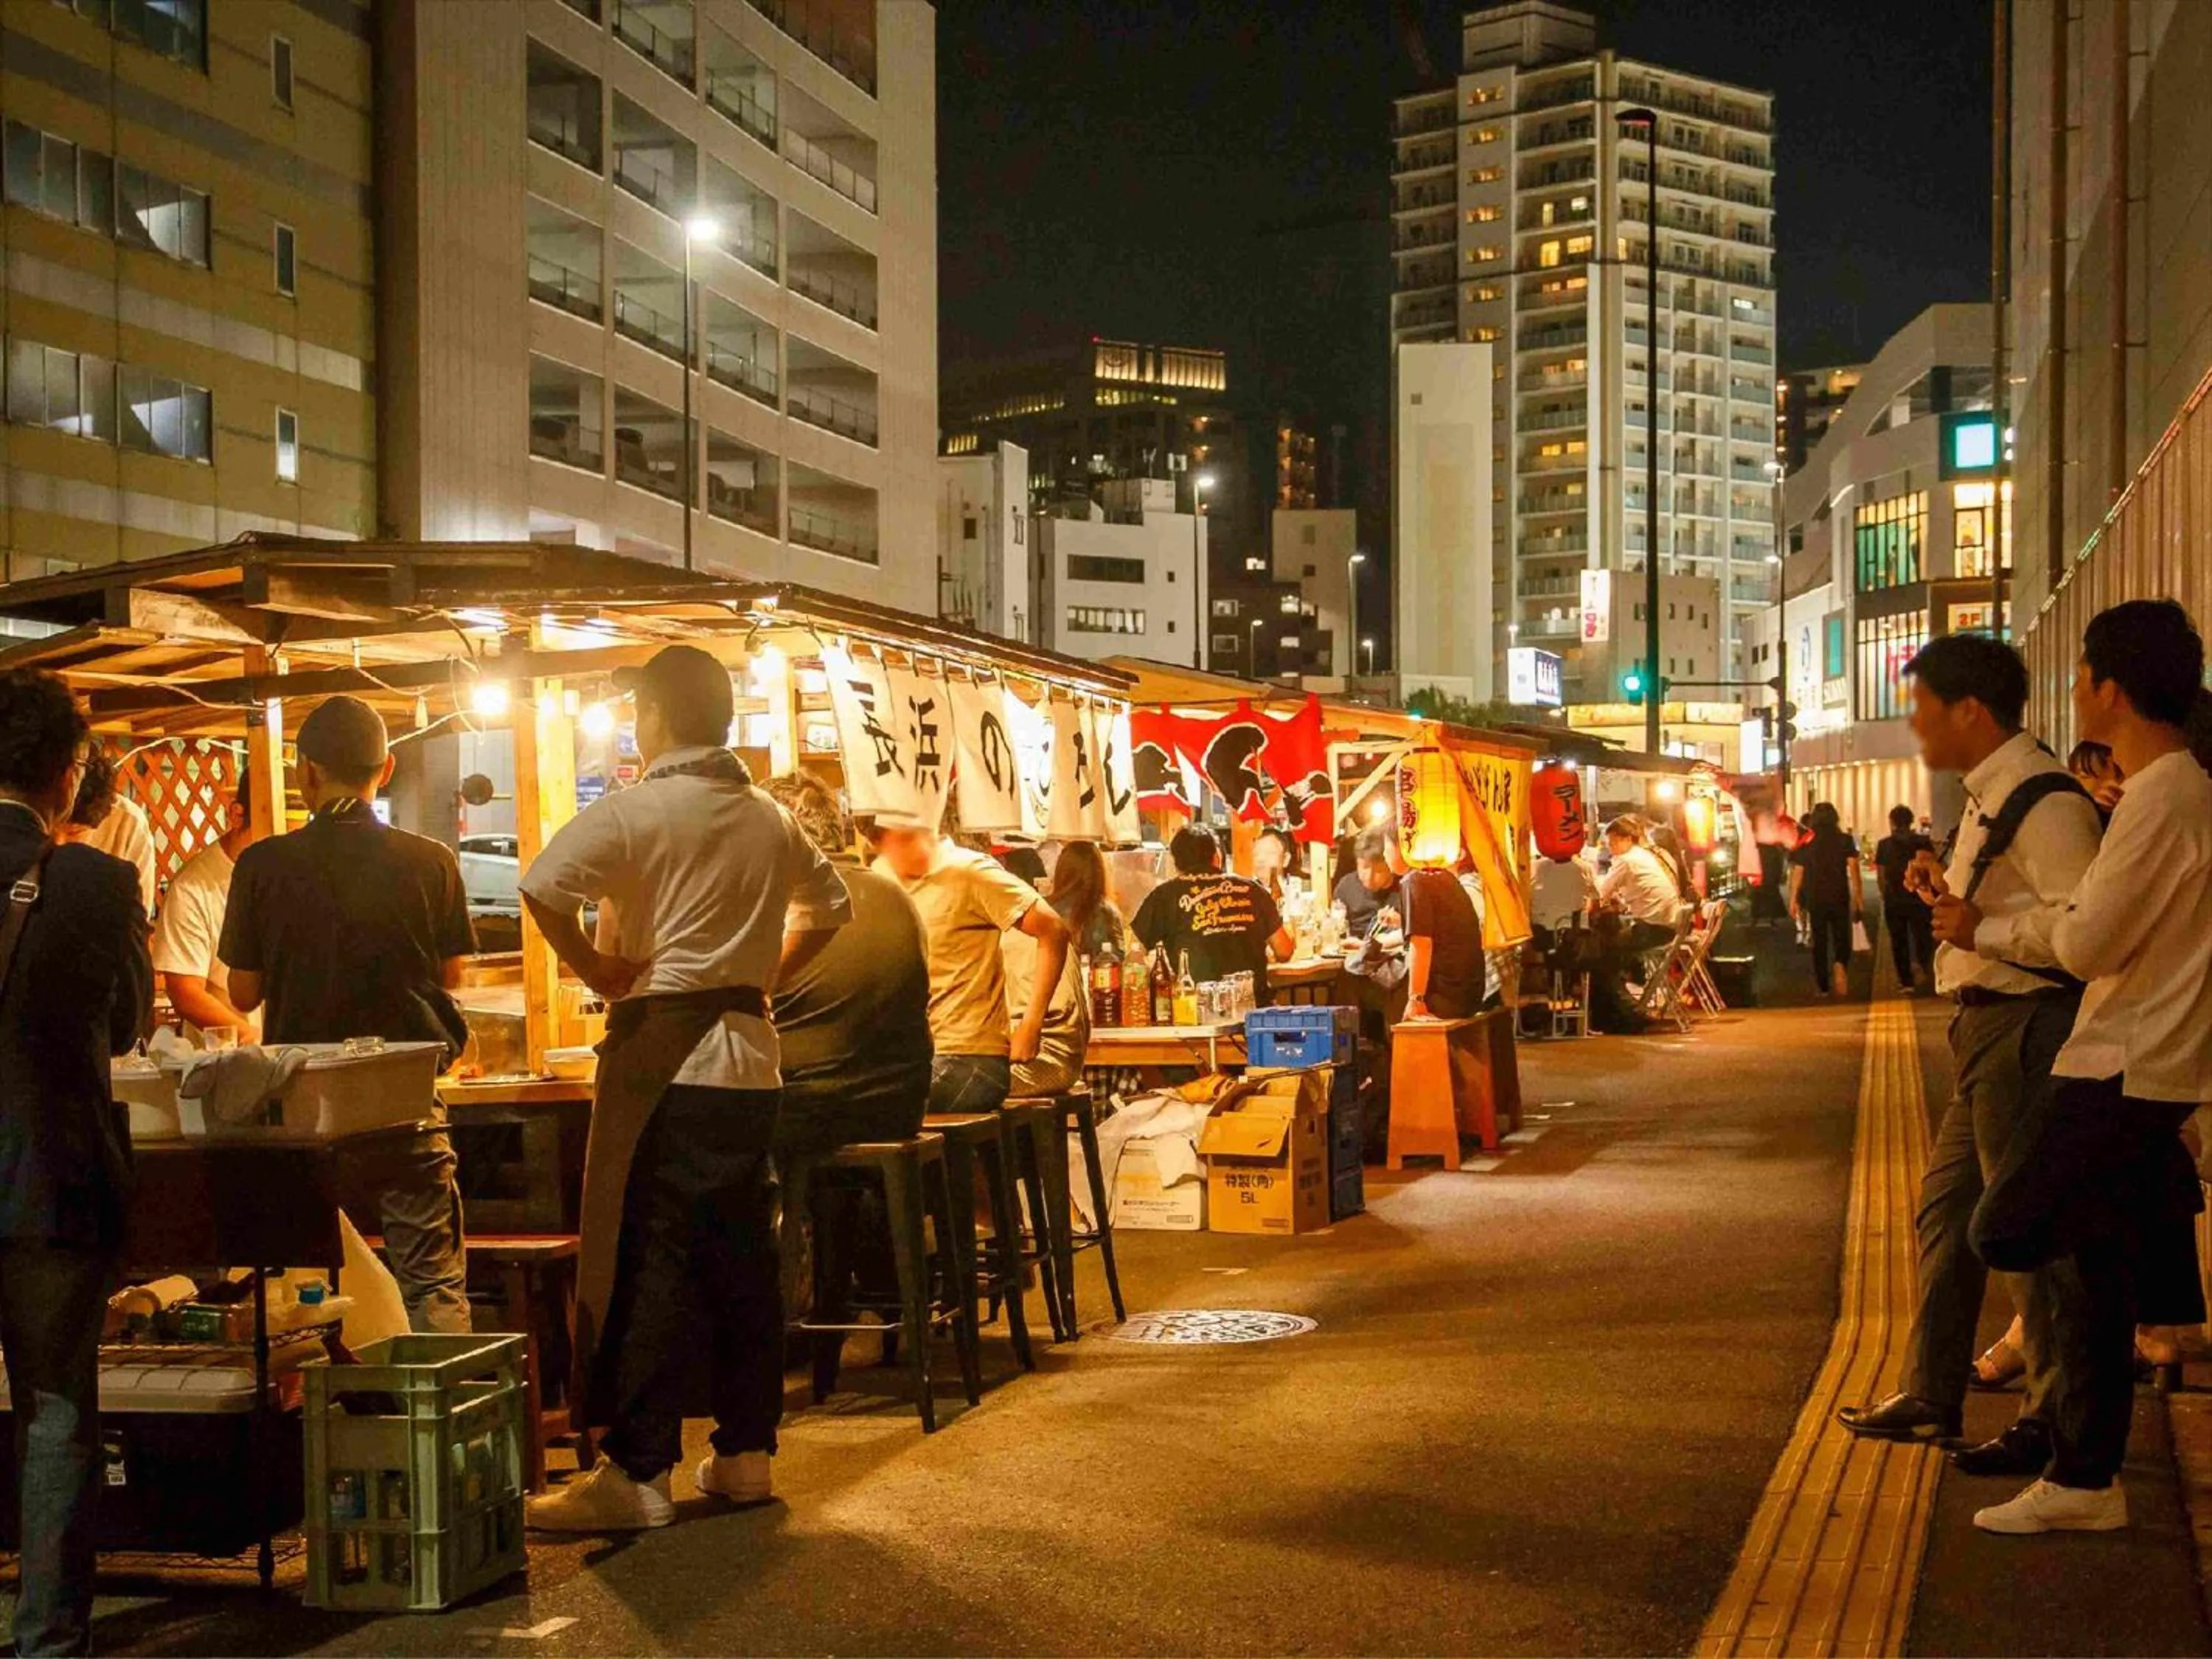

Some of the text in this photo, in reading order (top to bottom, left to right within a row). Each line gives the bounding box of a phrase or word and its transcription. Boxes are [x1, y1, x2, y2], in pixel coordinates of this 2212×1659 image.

[1554, 783, 1582, 843] ラーメン
[1240, 1192, 1260, 1204] 5L
